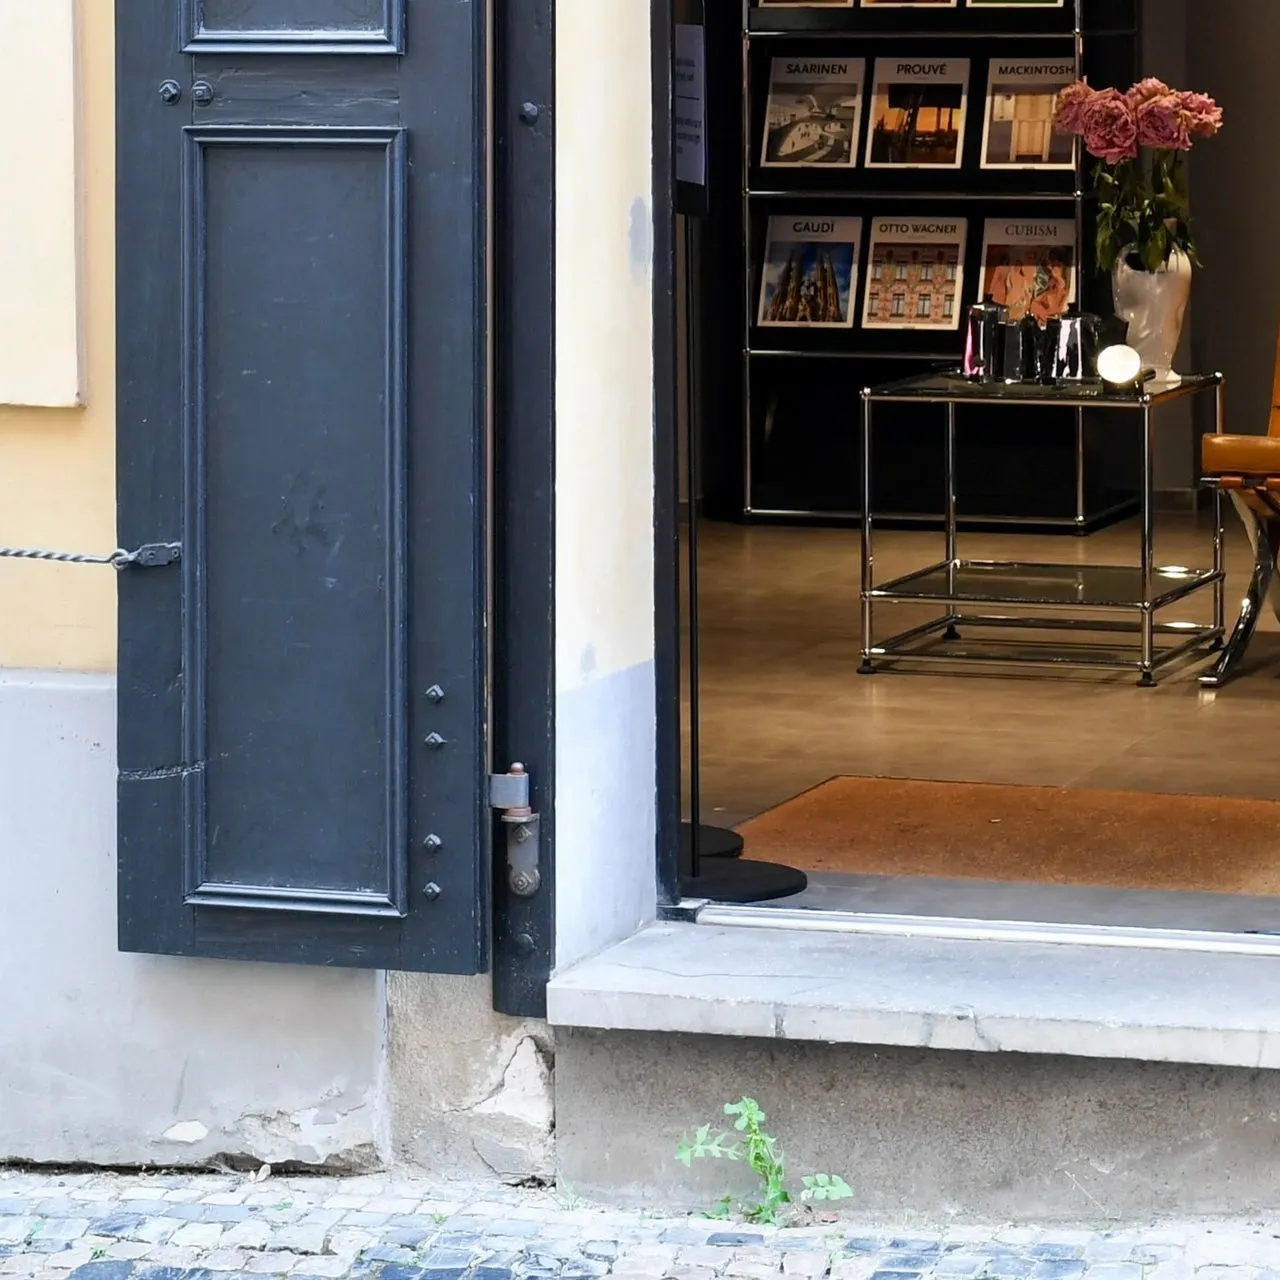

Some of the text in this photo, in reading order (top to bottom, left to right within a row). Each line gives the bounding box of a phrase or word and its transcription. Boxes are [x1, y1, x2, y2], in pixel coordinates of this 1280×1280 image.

[785, 63, 848, 75] SAARINEN
[896, 62, 947, 75] PROUVÉ
[998, 64, 1075, 76] MACKINTOSH
[879, 223, 957, 235] OTTO WAGNER
[1004, 225, 1058, 237] CUBISM
